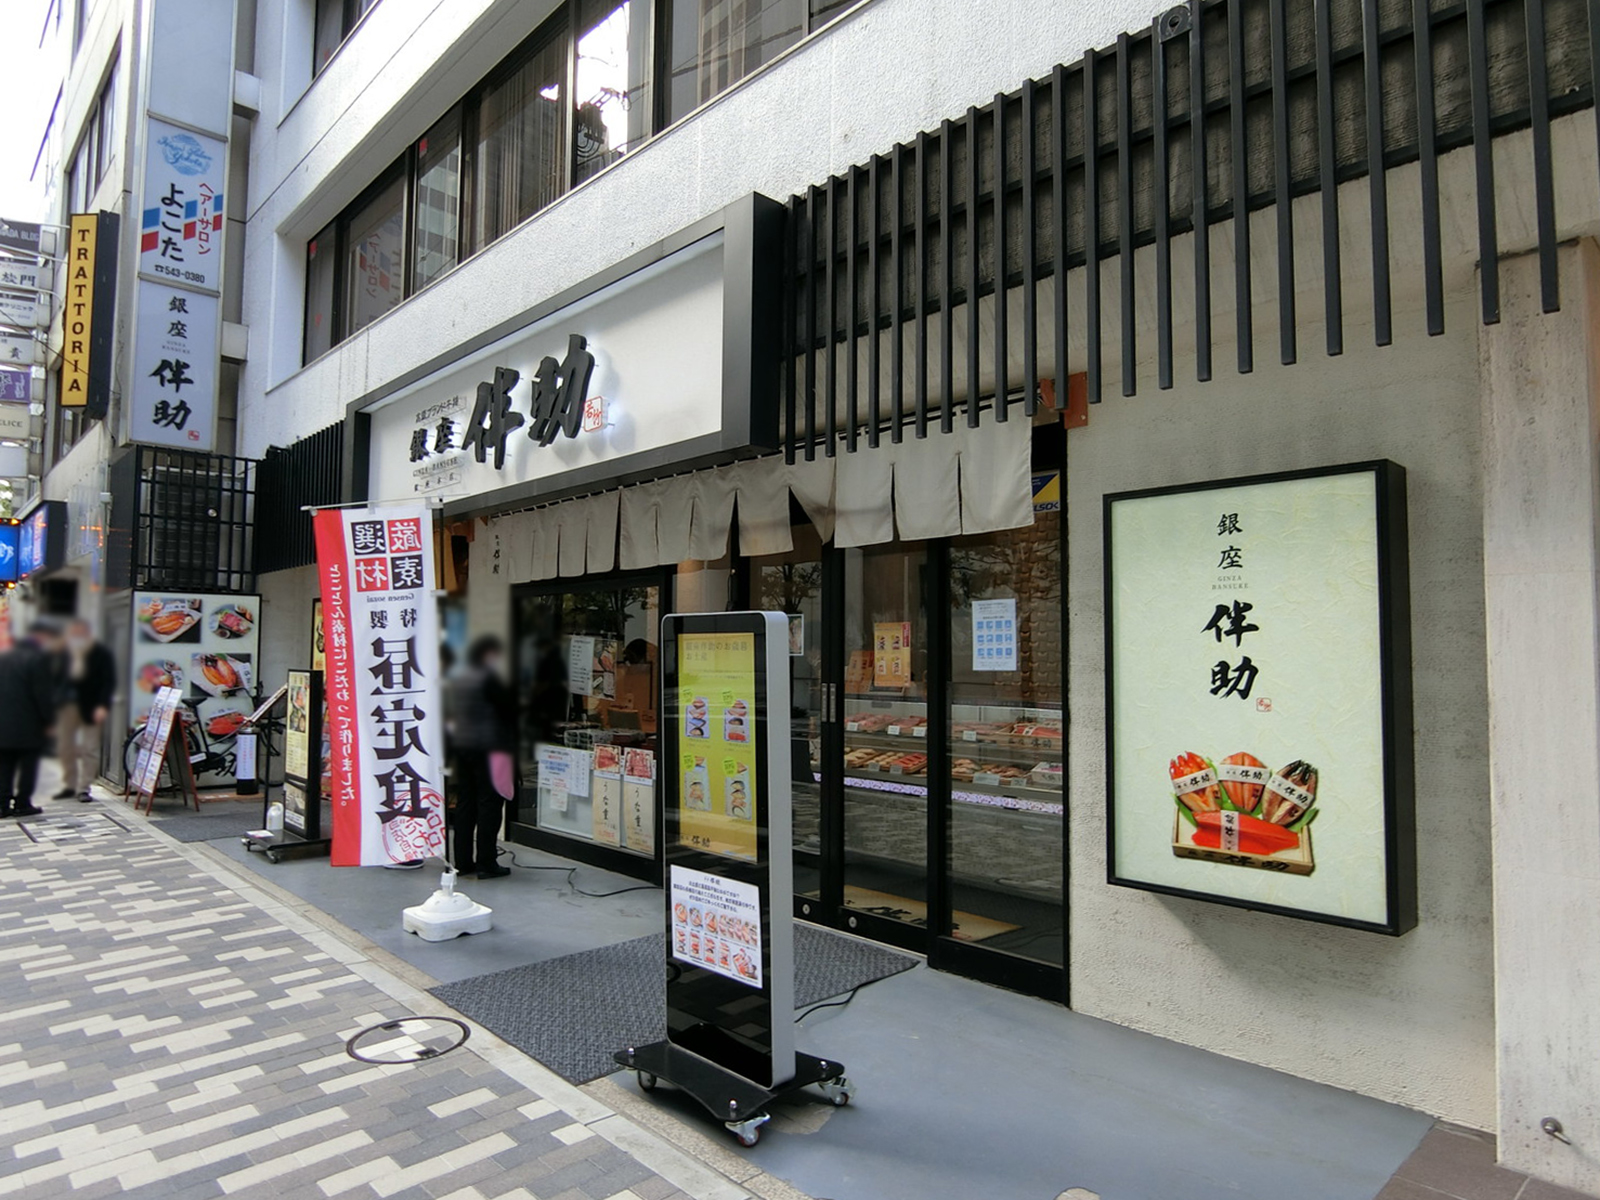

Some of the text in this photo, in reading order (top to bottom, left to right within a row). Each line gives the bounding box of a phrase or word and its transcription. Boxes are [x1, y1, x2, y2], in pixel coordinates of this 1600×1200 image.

[161, 182, 185, 262] よこた
[198, 182, 215, 256] ヘアーサロン
[68, 228, 90, 392] TRATTORIA
[168, 295, 190, 340] 銀座
[148, 357, 195, 433] 伴助
[461, 333, 596, 471] 伴助
[1216, 512, 1244, 570] 銀座
[1217, 574, 1242, 582] GINZA
[1211, 582, 1249, 590] BANSUKE
[1201, 599, 1260, 700] 伴助
